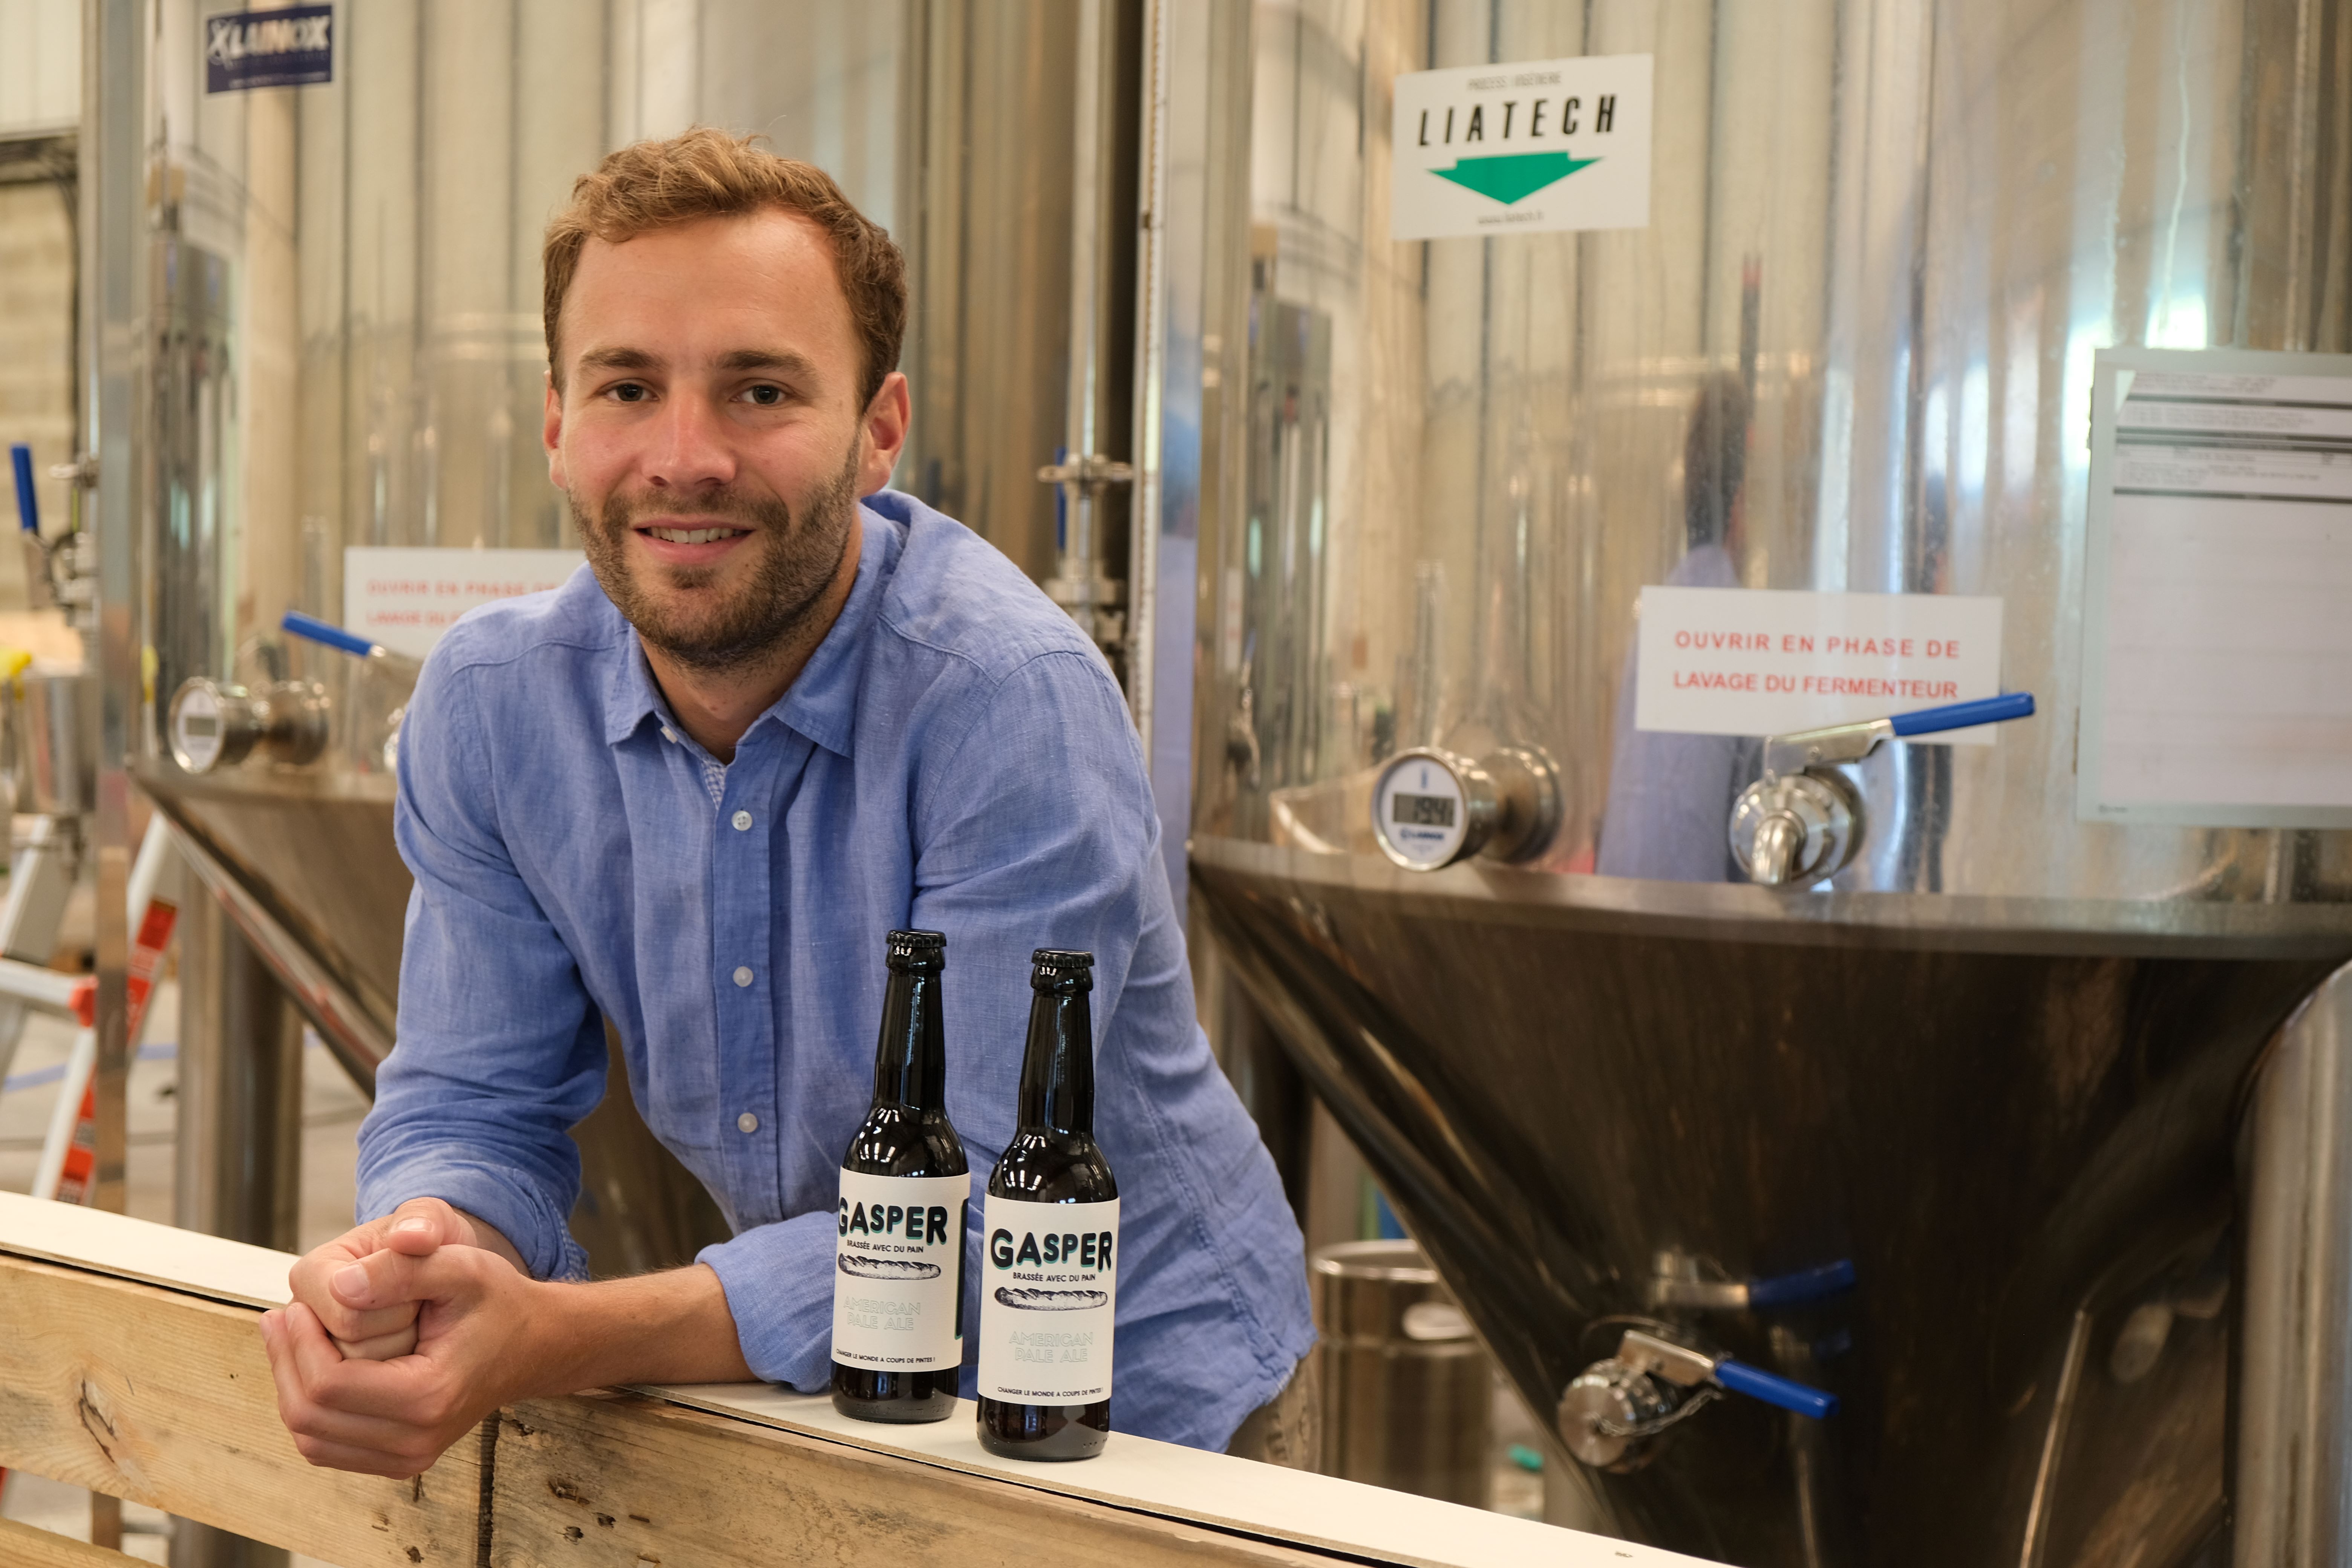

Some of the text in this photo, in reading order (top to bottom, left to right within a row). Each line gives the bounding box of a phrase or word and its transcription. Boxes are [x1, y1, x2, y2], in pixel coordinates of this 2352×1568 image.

[1419, 93, 1616, 147] LIATECH
[367, 580, 429, 596] OUVRIR
[435, 581, 459, 597] EN
[465, 581, 524, 597] PHASE
[1675, 630, 1960, 659] OUVRIR EN PHASE DE
[1674, 671, 1958, 698] LAVAGE DU FERMENTEUR
[839, 1197, 948, 1246] GASPER
[847, 1239, 870, 1250] BRASSÉE
[872, 1244, 891, 1253] AVEC
[991, 1228, 1112, 1272] GASPER
[1013, 1272, 1043, 1282] BRASSÉE
[843, 1297, 921, 1315] AMERICAN
[847, 1312, 914, 1331] PALE ALE
[1009, 1331, 1093, 1347] AMERICAN
[836, 1348, 851, 1358] CHANGER
[1015, 1348, 1088, 1363] PALE ALE
[997, 1386, 1022, 1395] CHANGER
